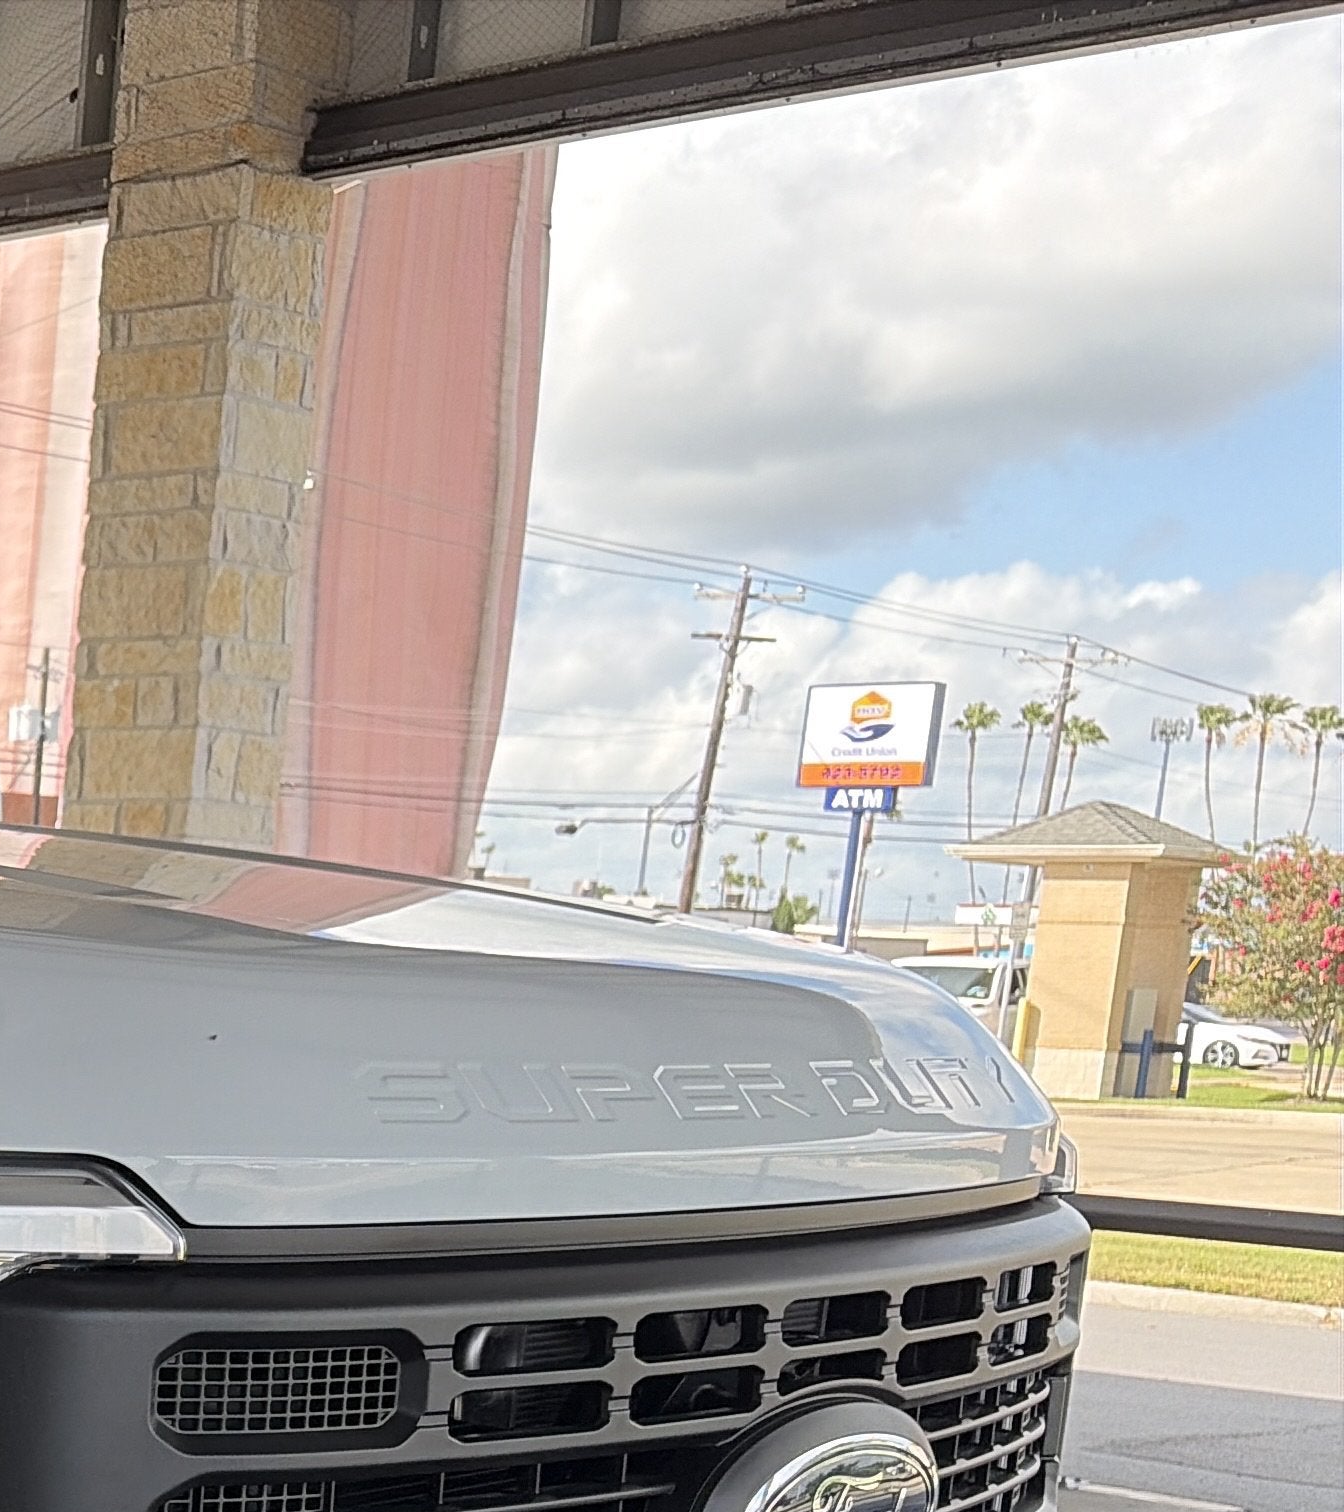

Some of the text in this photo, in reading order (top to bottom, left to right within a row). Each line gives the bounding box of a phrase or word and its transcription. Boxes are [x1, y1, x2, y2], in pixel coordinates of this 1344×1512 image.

[831, 746, 898, 757] Credit Union
[830, 788, 884, 809] ATM
[358, 1062, 810, 1125] SUPER
